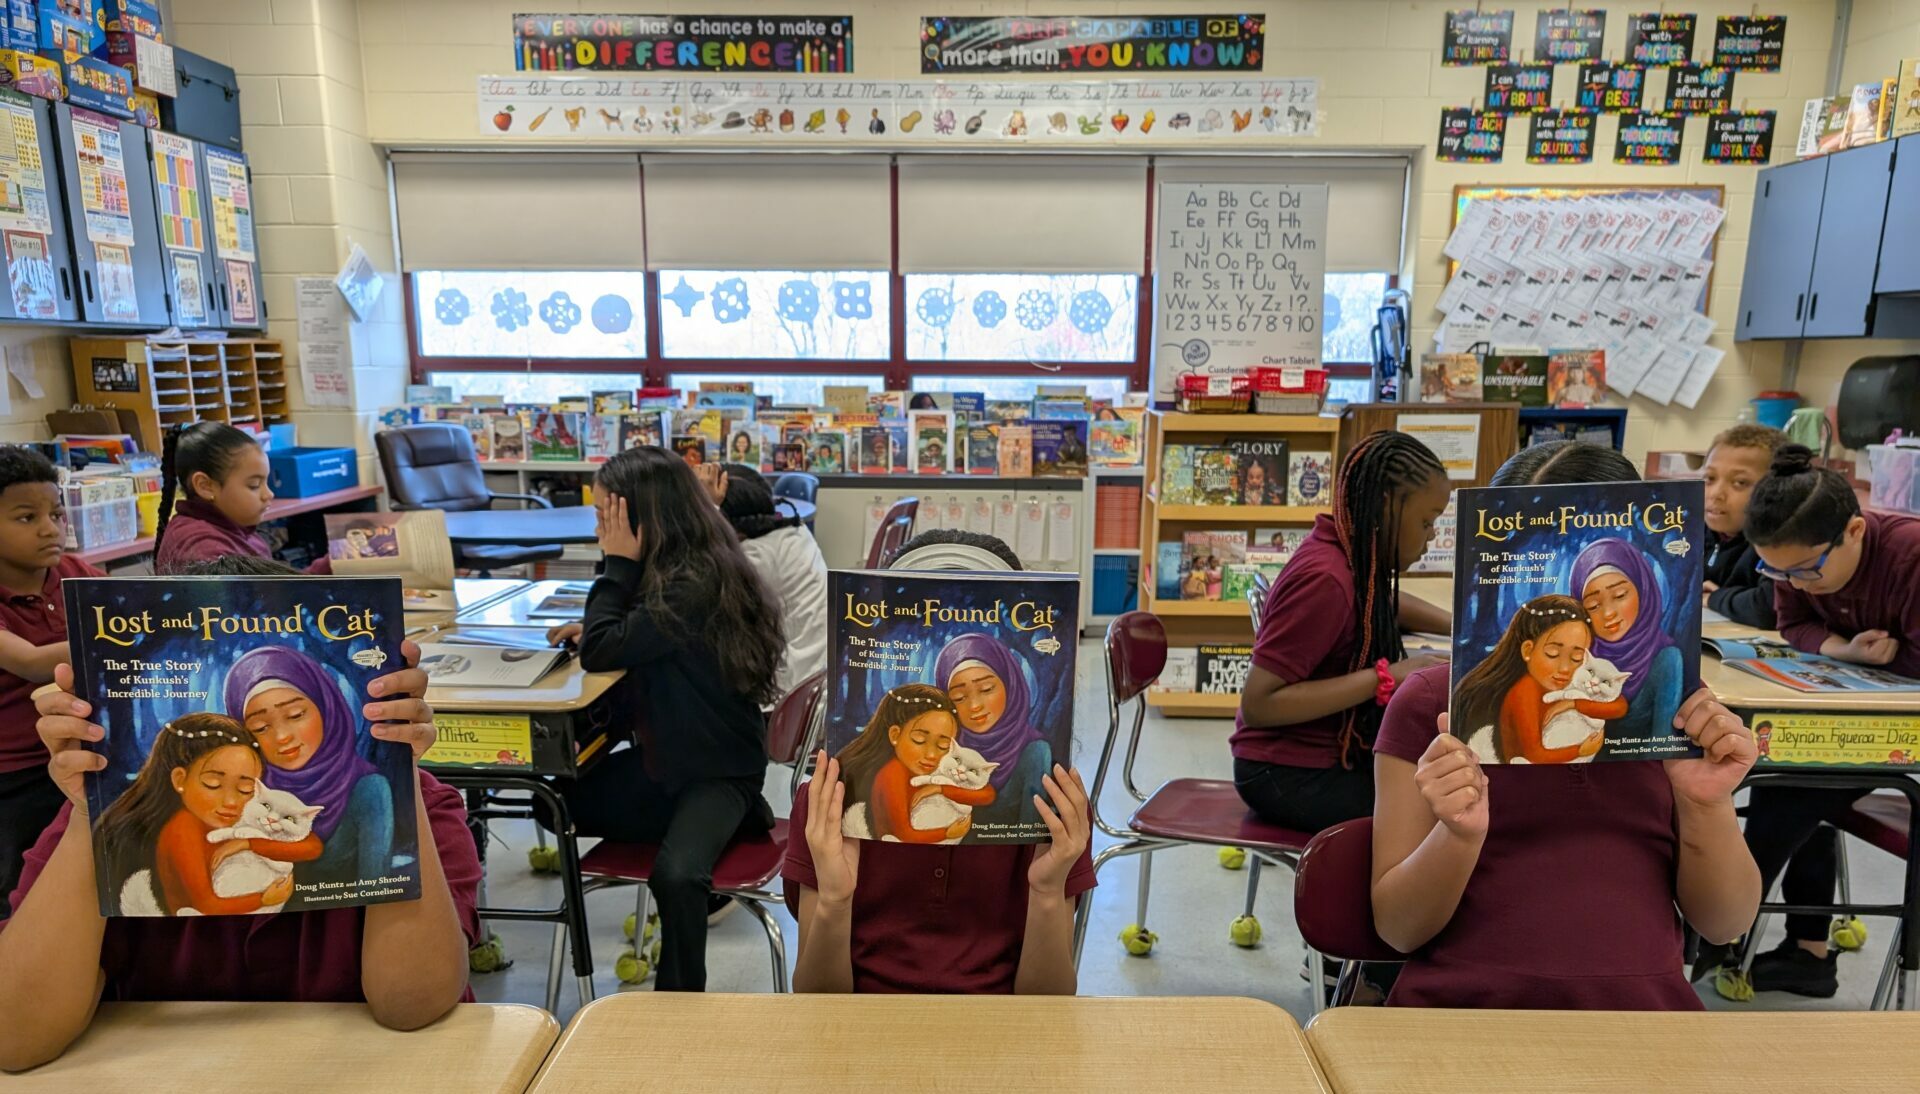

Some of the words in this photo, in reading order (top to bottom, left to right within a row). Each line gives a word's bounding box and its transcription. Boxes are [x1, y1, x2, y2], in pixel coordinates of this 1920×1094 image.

[524, 19, 633, 36] EVERYONE
[639, 19, 669, 34] has
[674, 22, 685, 34] a
[690, 19, 752, 35] chance
[757, 20, 775, 35] to
[780, 20, 826, 36] make
[831, 23, 842, 36] a
[1076, 20, 1198, 37] CAPABLE
[1207, 20, 1238, 36] OF
[1554, 18, 1568, 26] can
[1642, 22, 1656, 30] can
[1588, 30, 1601, 38] and
[1650, 31, 1672, 40] with
[1746, 27, 1763, 35] can
[1456, 34, 1466, 44] of
[1467, 36, 1500, 46] learning
[1764, 40, 1781, 48] when
[576, 40, 794, 66] DIFFERENCE
[942, 48, 1002, 66] more
[1008, 44, 1060, 66] than
[1068, 43, 1134, 67] YOU
[1146, 42, 1244, 66] KNOW
[1447, 47, 1470, 58] NEW
[1498, 76, 1513, 84] can
[1592, 71, 1609, 83] will
[1616, 70, 1636, 88] DO
[1684, 75, 1699, 84] am
[1702, 70, 1726, 85] NOT
[1489, 91, 1509, 106] MY
[1511, 91, 1547, 106] BRAIN.
[1582, 91, 1604, 106] MY
[1604, 90, 1638, 106] BEST.
[1675, 86, 1708, 98] afraid
[1710, 86, 1725, 97] of
[1452, 118, 1467, 127] can
[1470, 117, 1504, 132] REACH
[1542, 118, 1556, 127] can
[1556, 117, 1578, 128] COME
[1579, 117, 1590, 128] UP
[1645, 116, 1668, 126] value
[1721, 123, 1735, 131] can
[1536, 130, 1552, 139] with
[1720, 133, 1742, 142] from
[1746, 134, 1760, 144] my
[1442, 137, 1460, 150] my
[1186, 191, 1207, 208] Aa
[1218, 191, 1238, 207] Bb
[1250, 191, 1269, 208] Cc
[1279, 192, 1300, 208] Dd
[1186, 212, 1205, 228] Ee
[1218, 212, 1236, 228] Ff
[1246, 212, 1269, 235] Gg
[1278, 212, 1300, 228] Hh
[12, 239, 26, 248] Rule
[28, 240, 40, 249] #10
[1170, 231, 1184, 248] Ii
[1196, 232, 1210, 256] Jj
[1223, 232, 1243, 248] Kk
[1255, 233, 1270, 249] Ll
[1282, 233, 1316, 250] Mm
[1184, 253, 1209, 269] Nn
[1216, 253, 1239, 269] Oo
[1246, 253, 1264, 275] Pp
[1272, 254, 1299, 278] Qq
[1173, 272, 1191, 289] Rr
[1202, 272, 1220, 290] Ss
[1228, 273, 1244, 290] Tt
[1253, 274, 1276, 290] Uu
[1290, 274, 1310, 290] Vv
[1165, 294, 1199, 310] Ww
[1206, 294, 1228, 310] Xx
[1236, 294, 1254, 317] Yy
[1261, 295, 1281, 312] Zz
[1262, 356, 1286, 364] Chart
[1288, 356, 1316, 365] Tablet
[1484, 375, 1545, 386] UNSTOPPABLE
[1232, 442, 1282, 456] GLORY
[1475, 508, 1524, 542] Lost
[1530, 512, 1553, 526] and
[1558, 502, 1633, 535] Found
[1643, 502, 1685, 534] Cat
[1480, 552, 1499, 562] The
[1502, 552, 1526, 562] True
[1528, 550, 1556, 562] Story
[1490, 564, 1499, 573] of
[1502, 564, 1544, 572] Kunkush's
[1479, 576, 1521, 585] Incredible
[1524, 575, 1558, 584] Journey
[844, 592, 889, 628] Lost
[894, 603, 918, 616] and
[922, 598, 1001, 628] Found
[1010, 601, 1056, 632] Cat
[92, 605, 155, 646] Lost
[162, 612, 193, 628] and
[198, 604, 304, 640] Found
[317, 605, 377, 640] Cat
[849, 636, 866, 646] The
[868, 638, 891, 648] True
[894, 639, 921, 652] Story
[868, 650, 910, 661] Kunkush's
[104, 660, 128, 671] The
[130, 660, 162, 671] True
[166, 660, 202, 674] Story
[849, 659, 888, 670] Incredible
[889, 662, 923, 674] Journey
[120, 675, 132, 685] of
[134, 675, 189, 685] Kunkush's
[107, 688, 160, 698] Incredible
[163, 690, 208, 700] Journey
[438, 726, 478, 743] Mitre
[1777, 727, 1824, 748] Jeyrian
[295, 883, 318, 892] Doug
[318, 882, 344, 890] Kuntz
[378, 875, 410, 884] Shrodes
[304, 894, 334, 902] Illustrated
[360, 887, 404, 898] Cornelison
